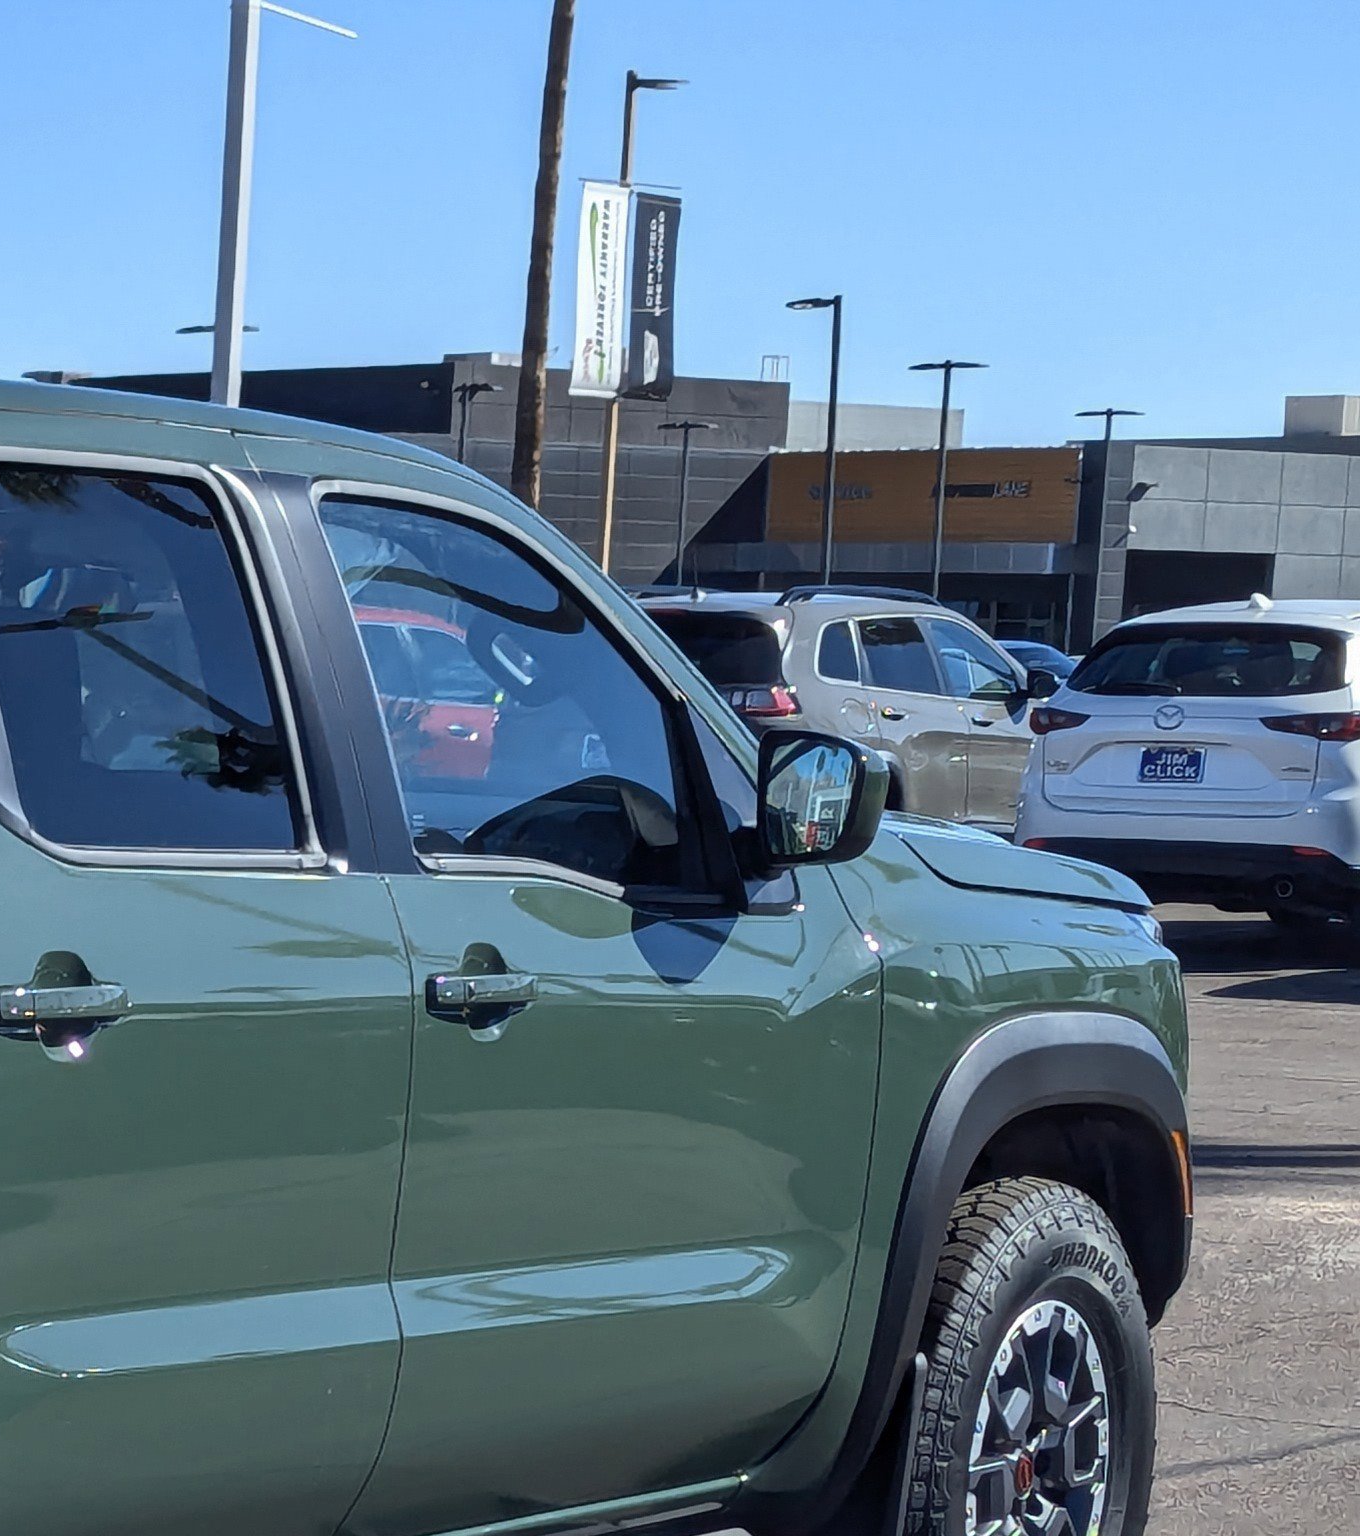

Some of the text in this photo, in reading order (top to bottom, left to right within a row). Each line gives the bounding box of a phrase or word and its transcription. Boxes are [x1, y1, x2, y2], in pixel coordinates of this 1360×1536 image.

[599, 199, 611, 280] WARRANTY
[645, 218, 657, 307] CERTIFIED
[1143, 764, 1198, 777] CLICK
[1156, 752, 1188, 766] JIM
